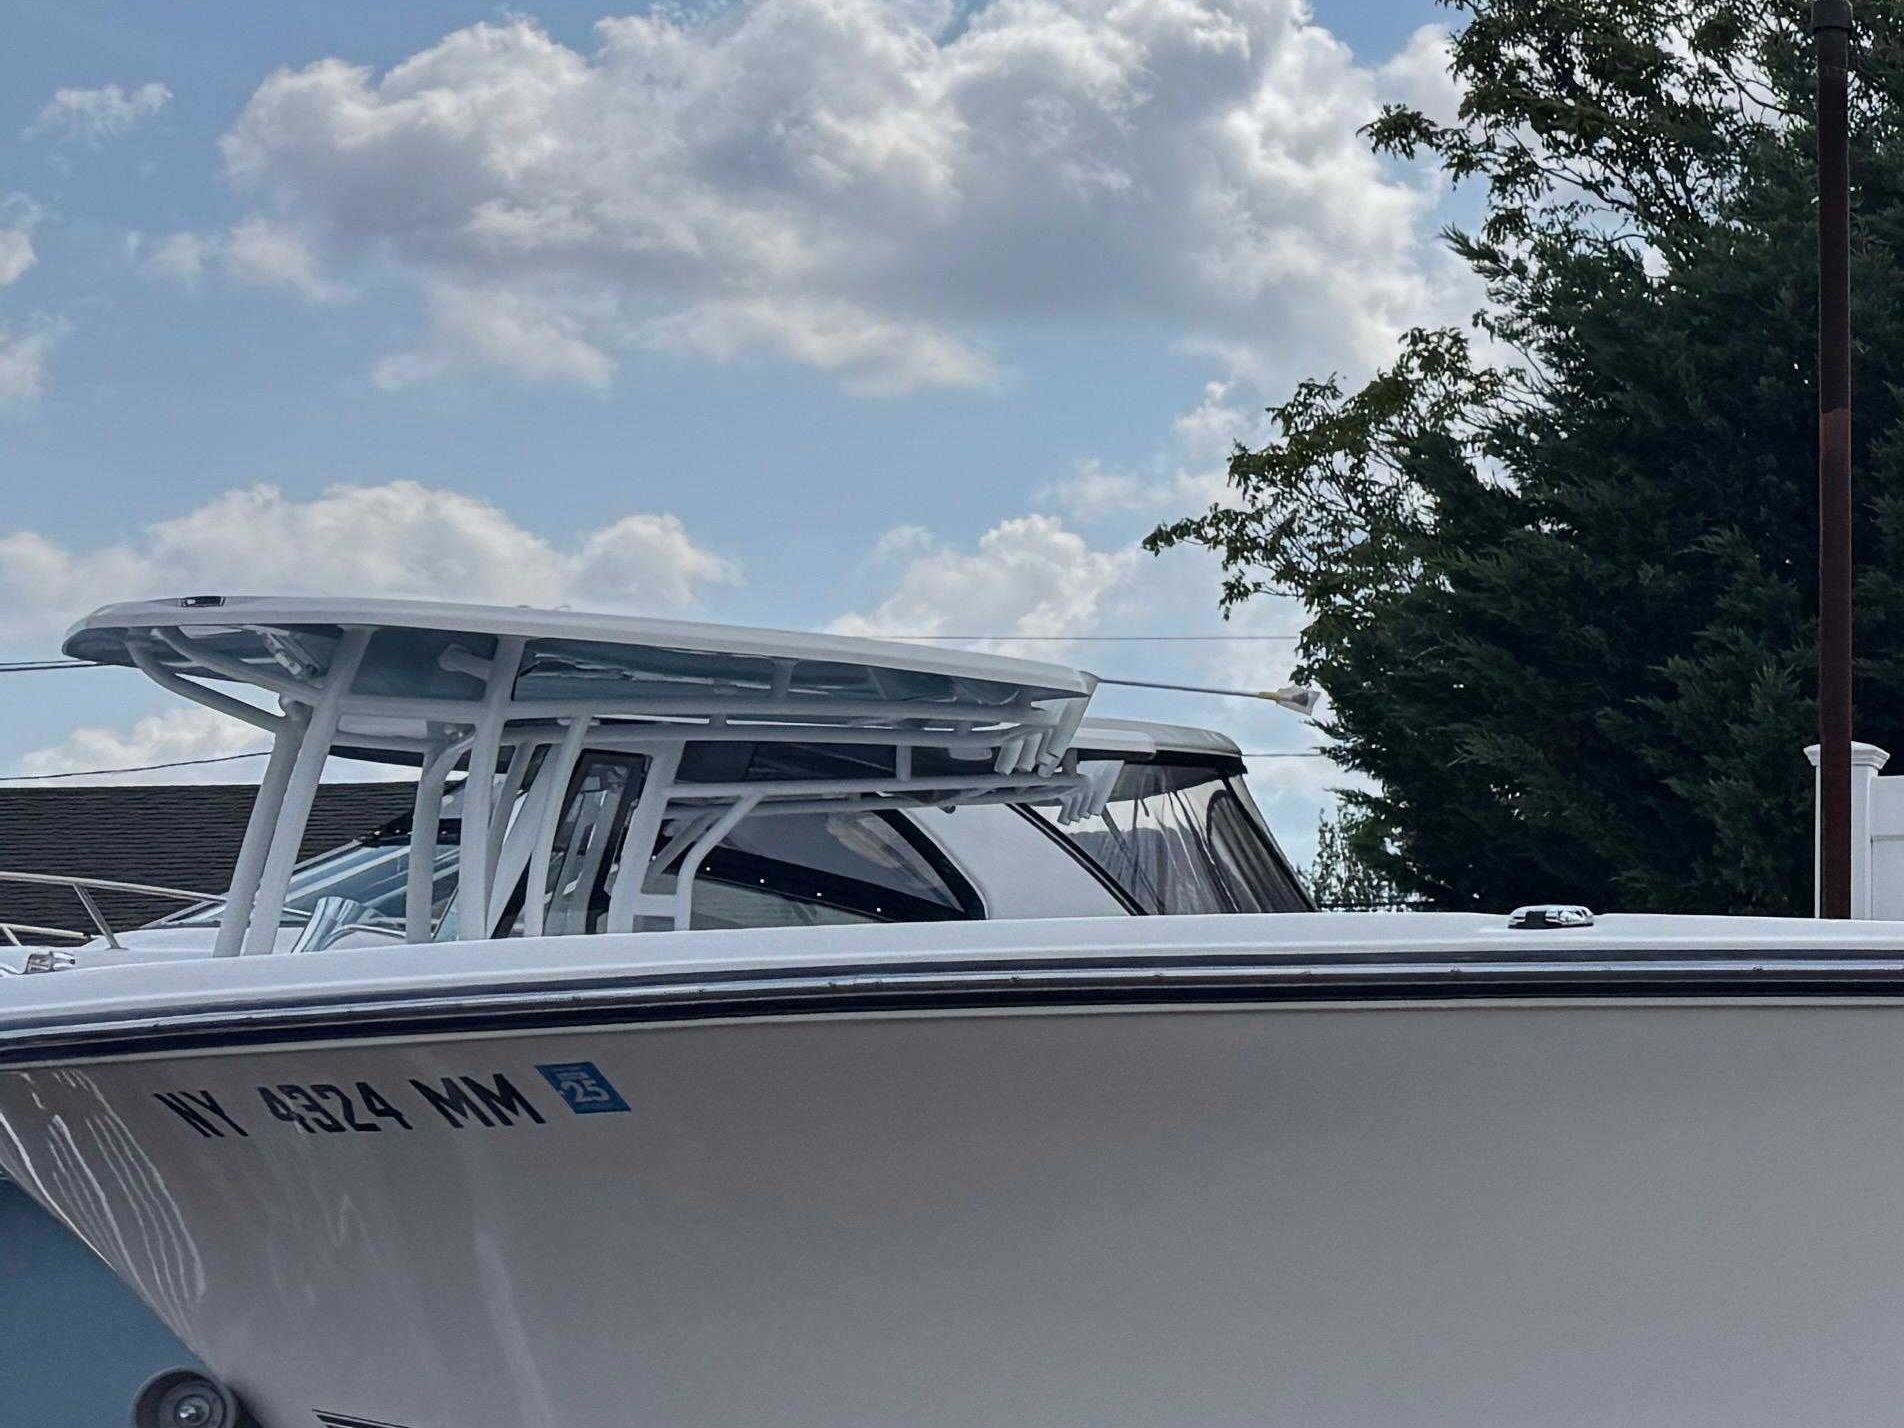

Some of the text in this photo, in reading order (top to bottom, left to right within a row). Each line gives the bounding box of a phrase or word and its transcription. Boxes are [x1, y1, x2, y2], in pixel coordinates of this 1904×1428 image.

[153, 1074, 547, 1138] NY 4324 MM
[560, 1079, 610, 1103] 25
